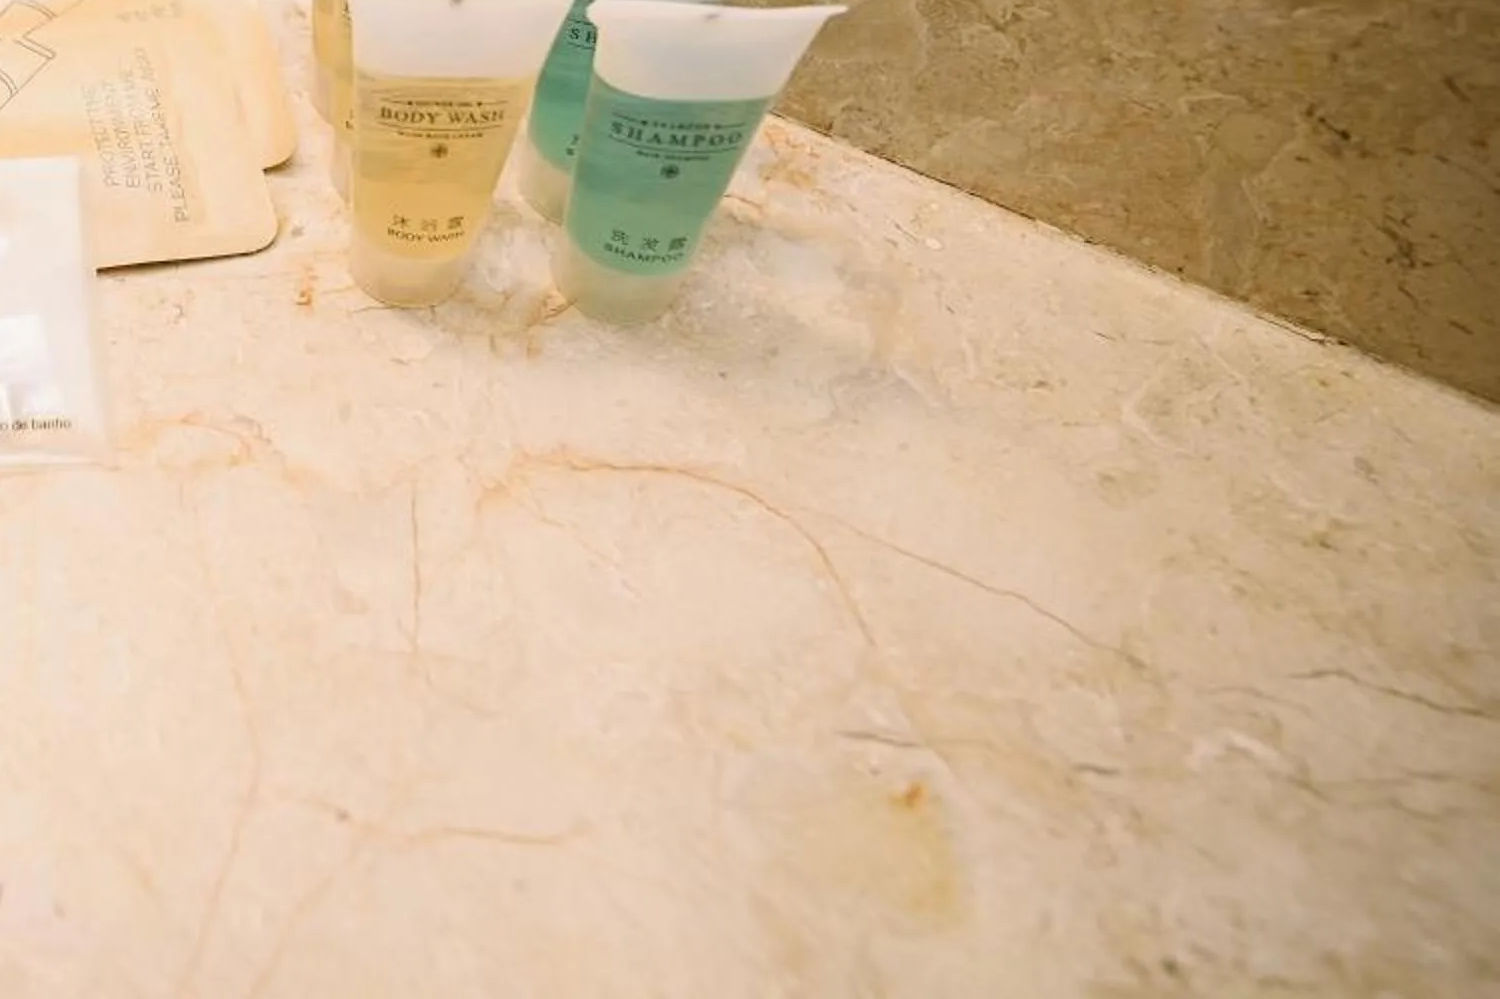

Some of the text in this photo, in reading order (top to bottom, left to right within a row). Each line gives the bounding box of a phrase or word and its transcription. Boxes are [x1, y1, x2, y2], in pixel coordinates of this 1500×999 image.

[380, 106, 504, 125] BODY WASH
[611, 121, 743, 147] SHAMPOO
[387, 227, 423, 242] BODY
[604, 242, 685, 263] SHAMPOO
